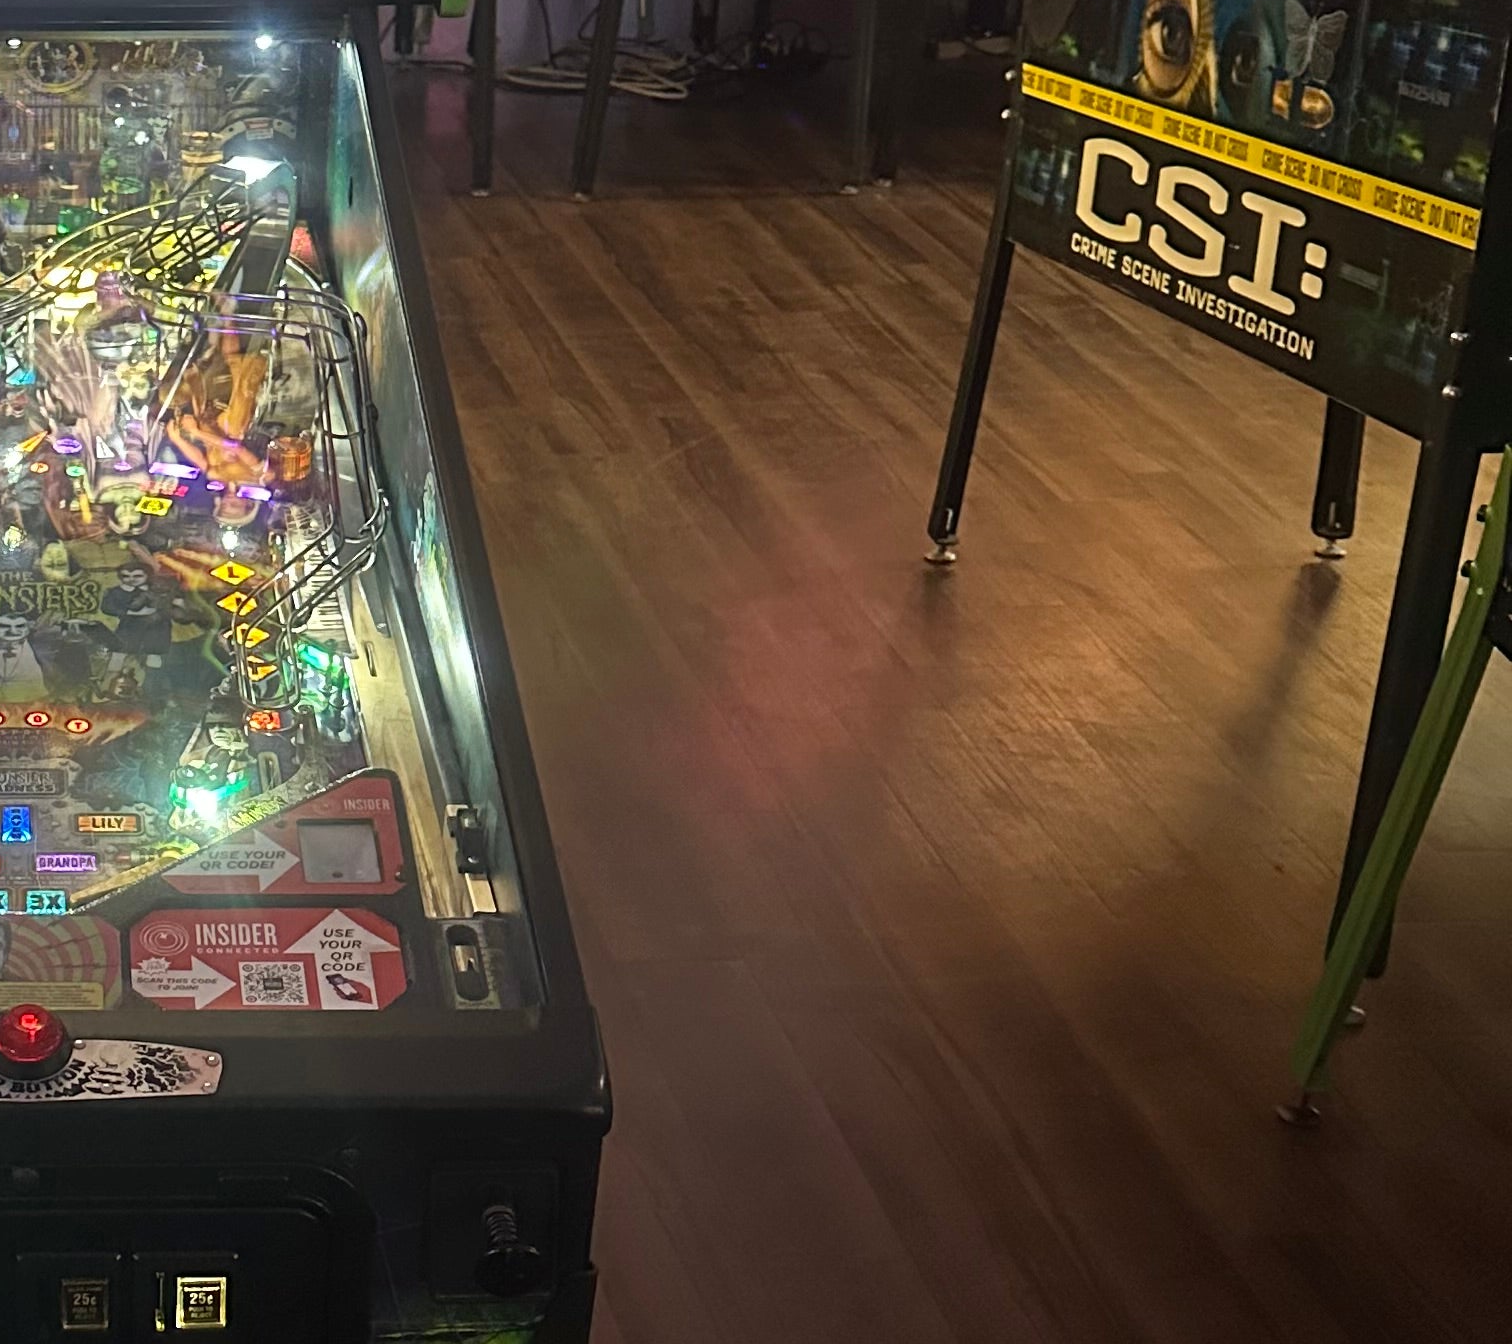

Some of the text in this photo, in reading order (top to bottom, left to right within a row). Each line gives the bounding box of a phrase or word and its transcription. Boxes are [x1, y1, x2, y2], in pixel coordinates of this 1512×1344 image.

[1374, 185, 1399, 214] CRIME
[1399, 194, 1426, 224] SCENE
[1428, 203, 1442, 229] DO
[1076, 138, 1328, 315] CSI:
[1071, 232, 1315, 360] CRIME SCENE INVESTIGATION
[343, 799, 390, 811] INSIDER
[91, 817, 124, 830] LILY
[209, 850, 287, 860] USE YOUR
[38, 857, 96, 869] GRANDPA
[200, 860, 275, 871] QR CODE!
[29, 894, 63, 910] 3X
[195, 923, 279, 946] INSIDER
[323, 928, 356, 939] USE
[319, 939, 363, 950] YOUR
[330, 951, 354, 962] QR
[321, 962, 366, 972] CODE
[8, 1058, 88, 1093] BUTTON
